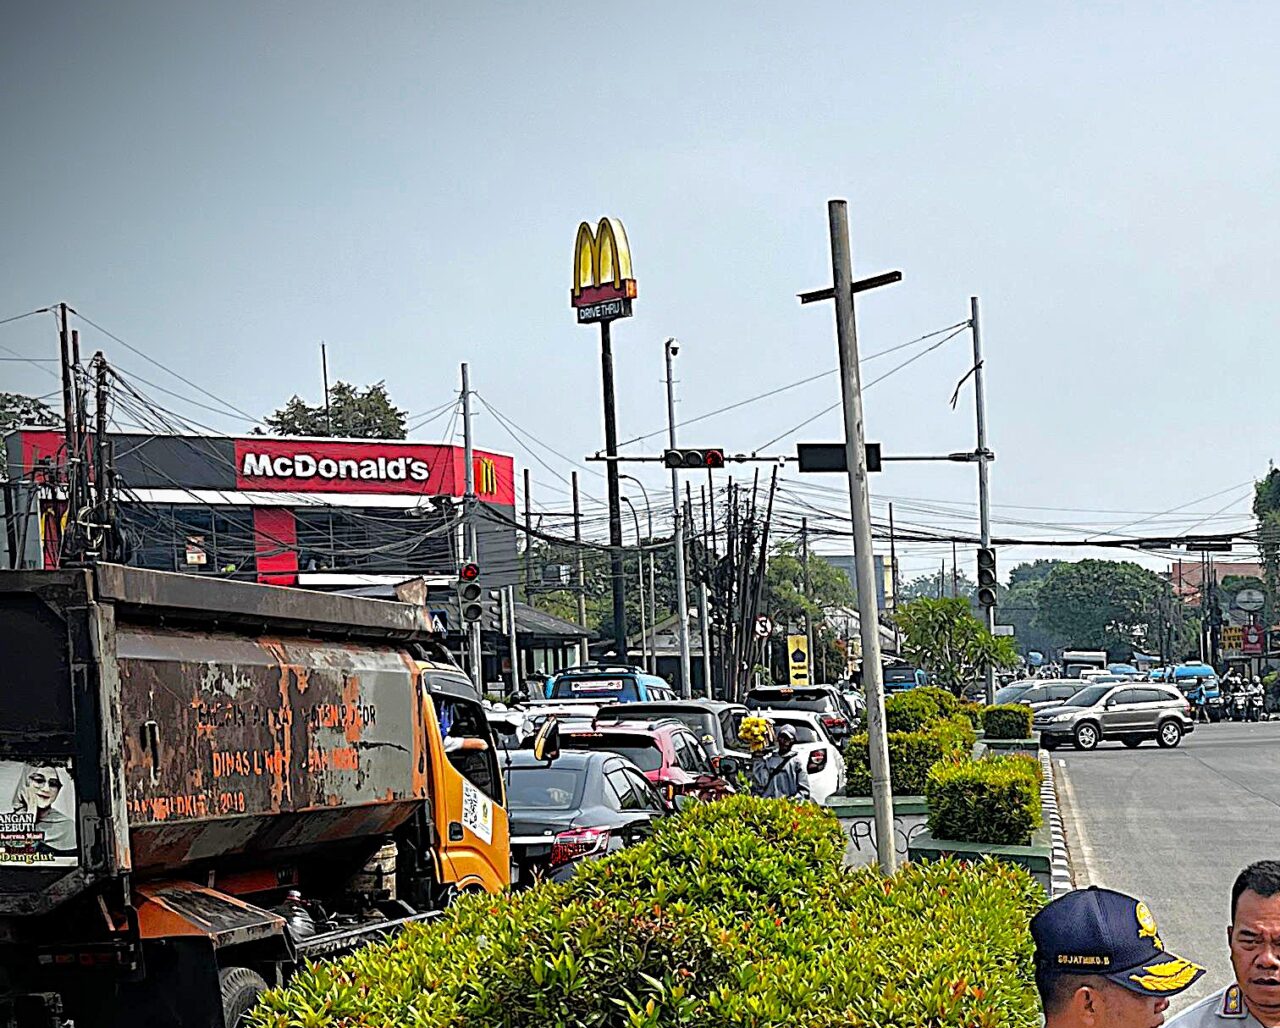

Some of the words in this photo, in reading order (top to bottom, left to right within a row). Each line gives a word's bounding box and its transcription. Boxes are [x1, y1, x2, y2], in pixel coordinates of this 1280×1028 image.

[243, 453, 430, 481] McDonald's
[220, 791, 245, 813] 2018
[2, 852, 54, 864] Dangdut
